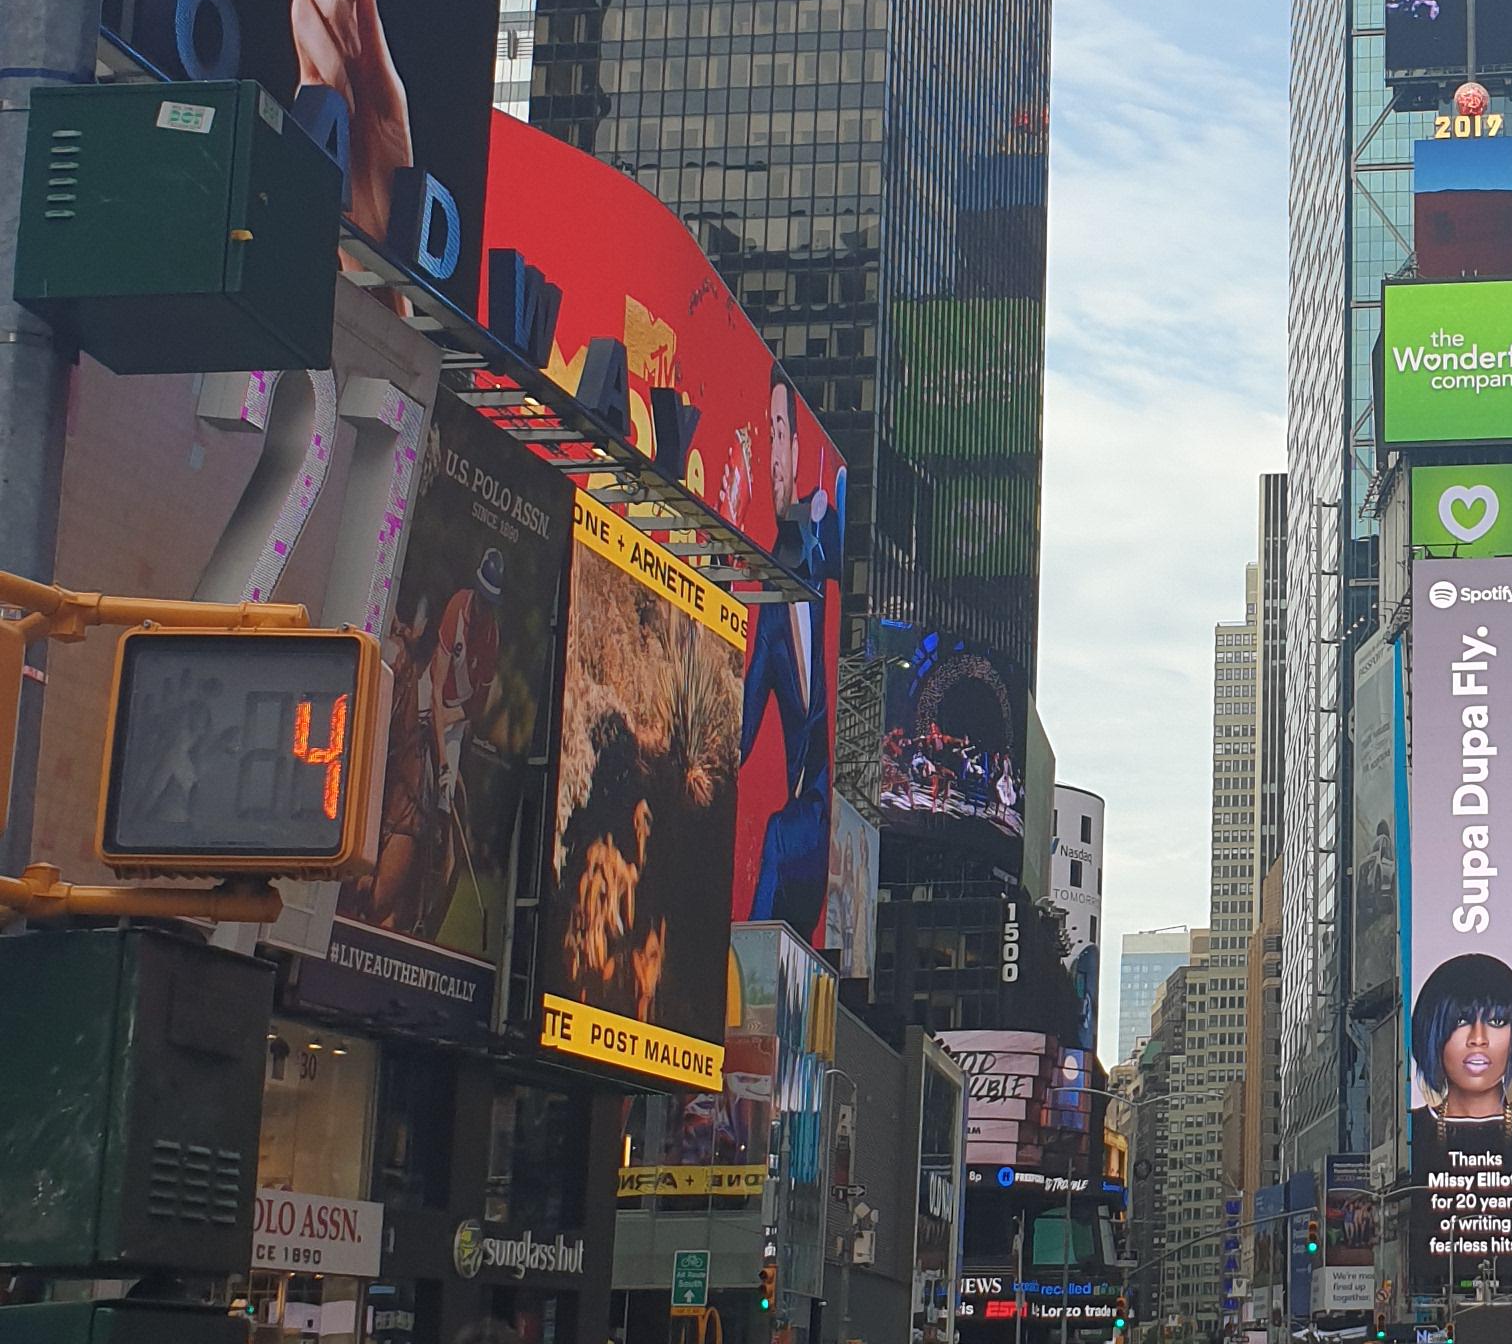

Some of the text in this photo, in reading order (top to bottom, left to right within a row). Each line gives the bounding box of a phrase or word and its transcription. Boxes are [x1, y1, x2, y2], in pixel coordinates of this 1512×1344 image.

[1430, 327, 1464, 347] the
[446, 448, 552, 540] U.S. POLO ASSN.
[630, 541, 706, 612] ARNETTE
[293, 693, 348, 820] 4
[1451, 626, 1498, 935] Supa Dupa Fly.
[1060, 845, 1093, 863] Nasdaq
[1001, 902, 1020, 983] 1500
[330, 942, 476, 1002] #LIVEAUTHENTICALLY
[591, 1023, 638, 1056] POST
[644, 1038, 713, 1077] MALONE
[1449, 1151, 1503, 1167] Thanks
[1428, 1172, 1475, 1191] Missy
[1431, 1193, 1453, 1209] for
[1456, 1193, 1477, 1209] 20
[300, 1204, 362, 1244] ASSN.
[1440, 1215, 1512, 1233] of writing
[482, 1229, 584, 1280] sunglass hut
[1429, 1237, 1488, 1253] fearless
[283, 1246, 322, 1265] 1890
[1332, 1272, 1357, 1281] We're
[1332, 1282, 1366, 1294] fired up
